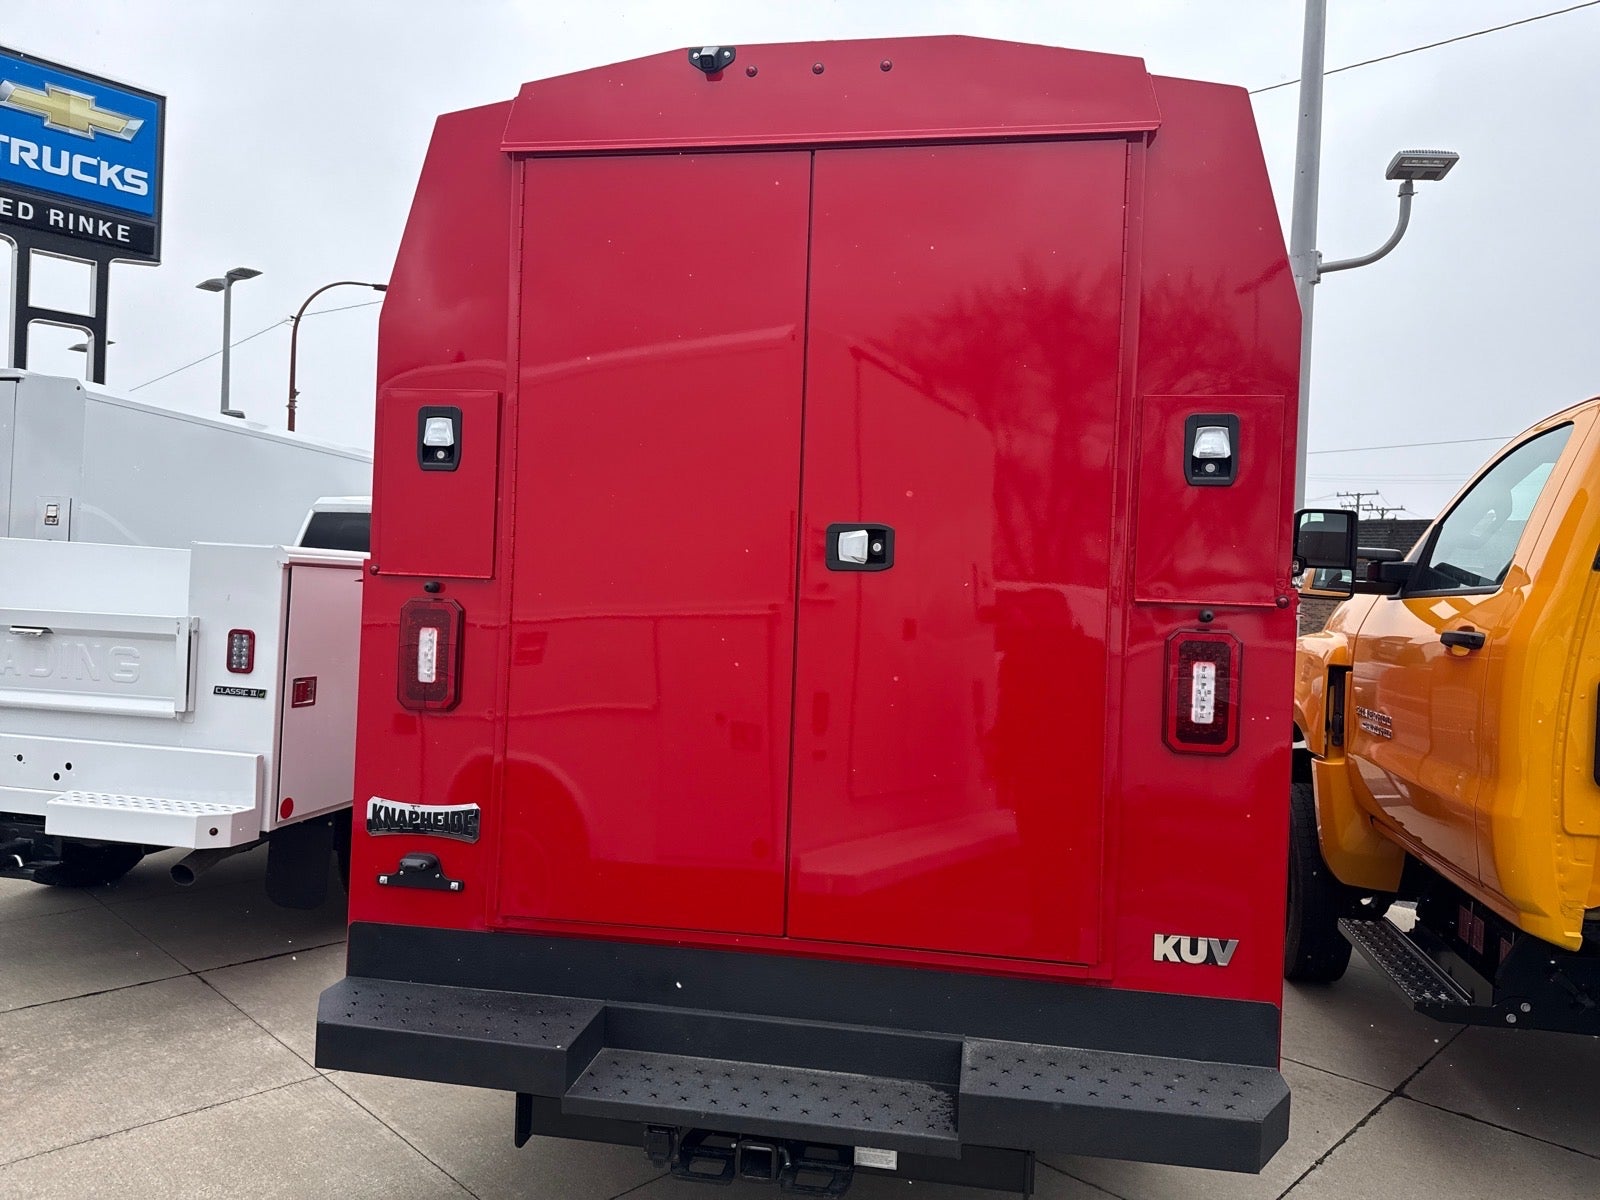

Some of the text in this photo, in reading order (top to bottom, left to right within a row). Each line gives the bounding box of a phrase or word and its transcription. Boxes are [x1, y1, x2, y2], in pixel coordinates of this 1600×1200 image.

[49, 208, 131, 243] RINKE
[215, 687, 249, 696] CLASSIC
[371, 803, 476, 838] KNAPHEIDE
[1153, 934, 1239, 966] KUV
